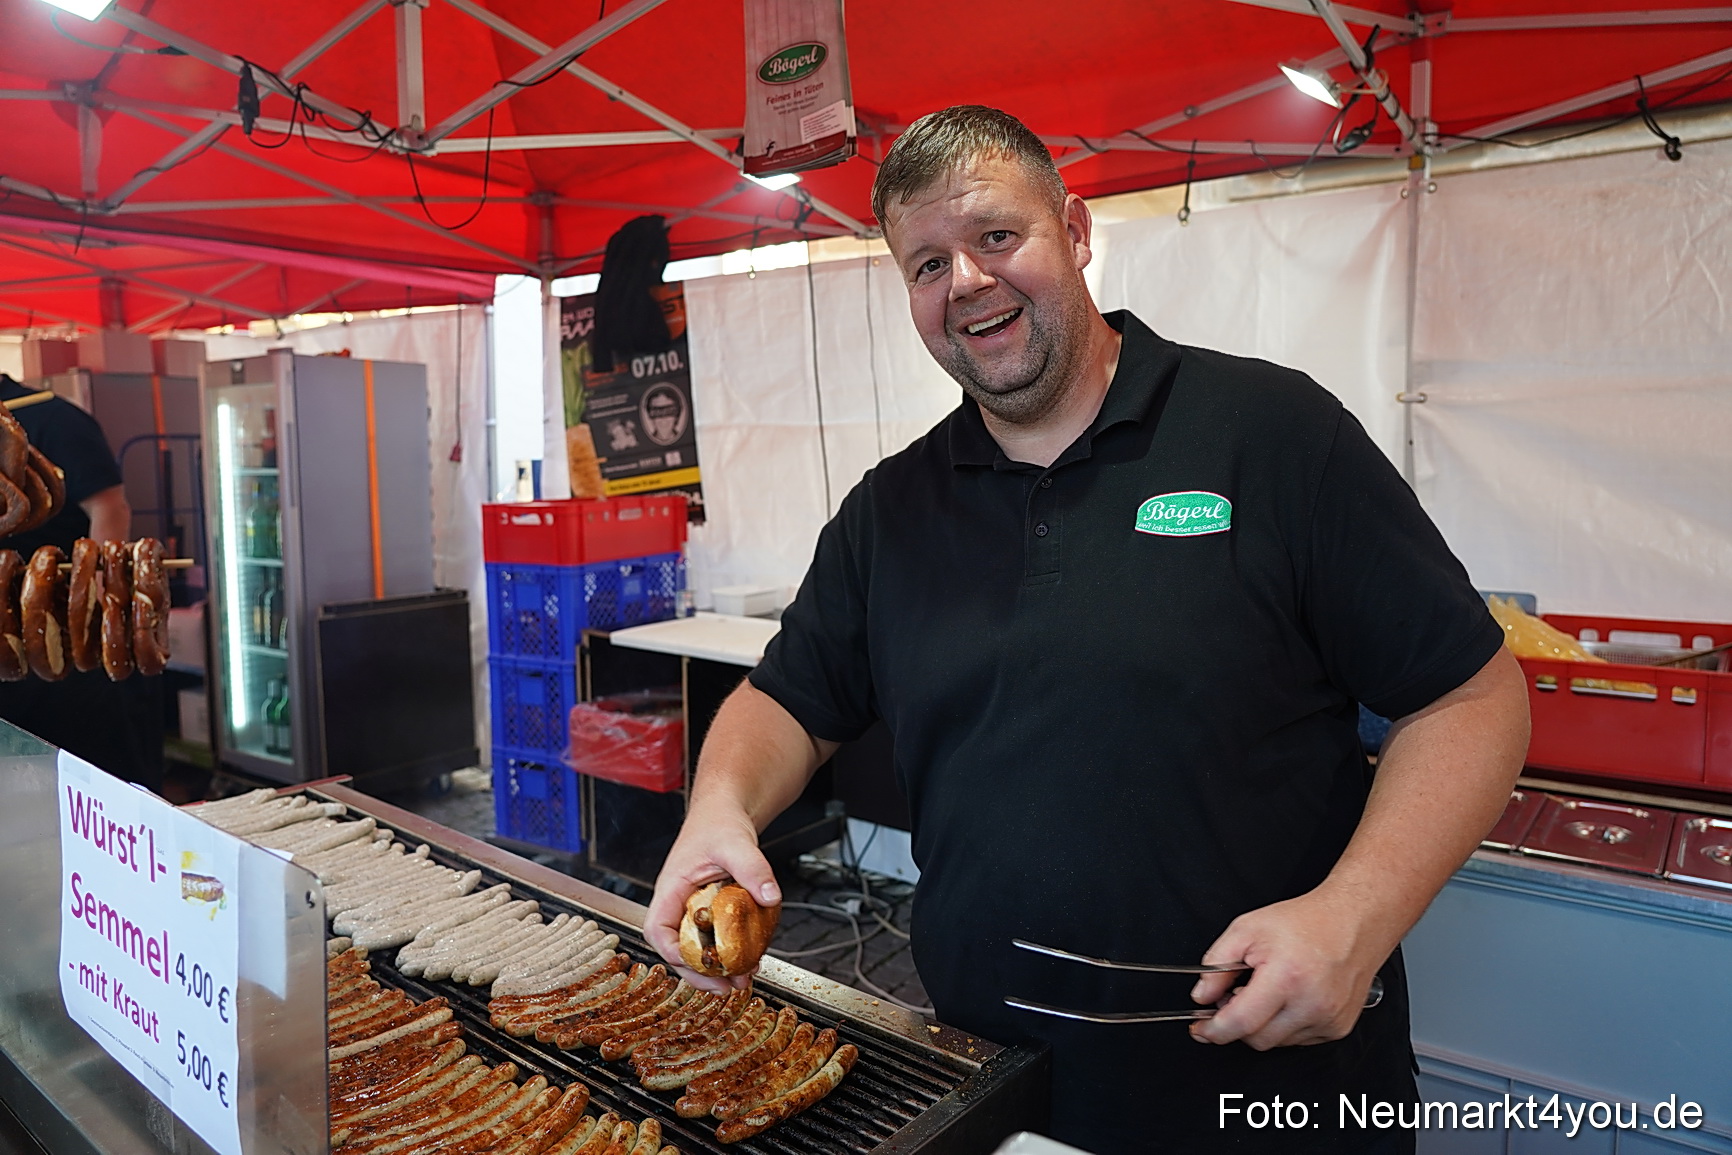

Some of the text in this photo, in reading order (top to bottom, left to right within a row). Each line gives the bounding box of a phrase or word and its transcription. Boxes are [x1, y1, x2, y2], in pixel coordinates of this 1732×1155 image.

[768, 46, 818, 76] Bögerl
[766, 92, 791, 105] Feines
[793, 88, 802, 98] in
[804, 82, 824, 95] Tüten
[631, 350, 684, 378] 07.10.
[1143, 501, 1224, 526] Bögerl
[1152, 524, 1163, 532] ich
[1165, 525, 1191, 533] besser
[1193, 523, 1217, 532] essen
[71, 872, 230, 1024] Semmel 4,00 €
[79, 961, 108, 1003] mit
[114, 977, 160, 1044] Kraut
[177, 1029, 211, 1091] 5,00
[218, 1070, 229, 1108] €
